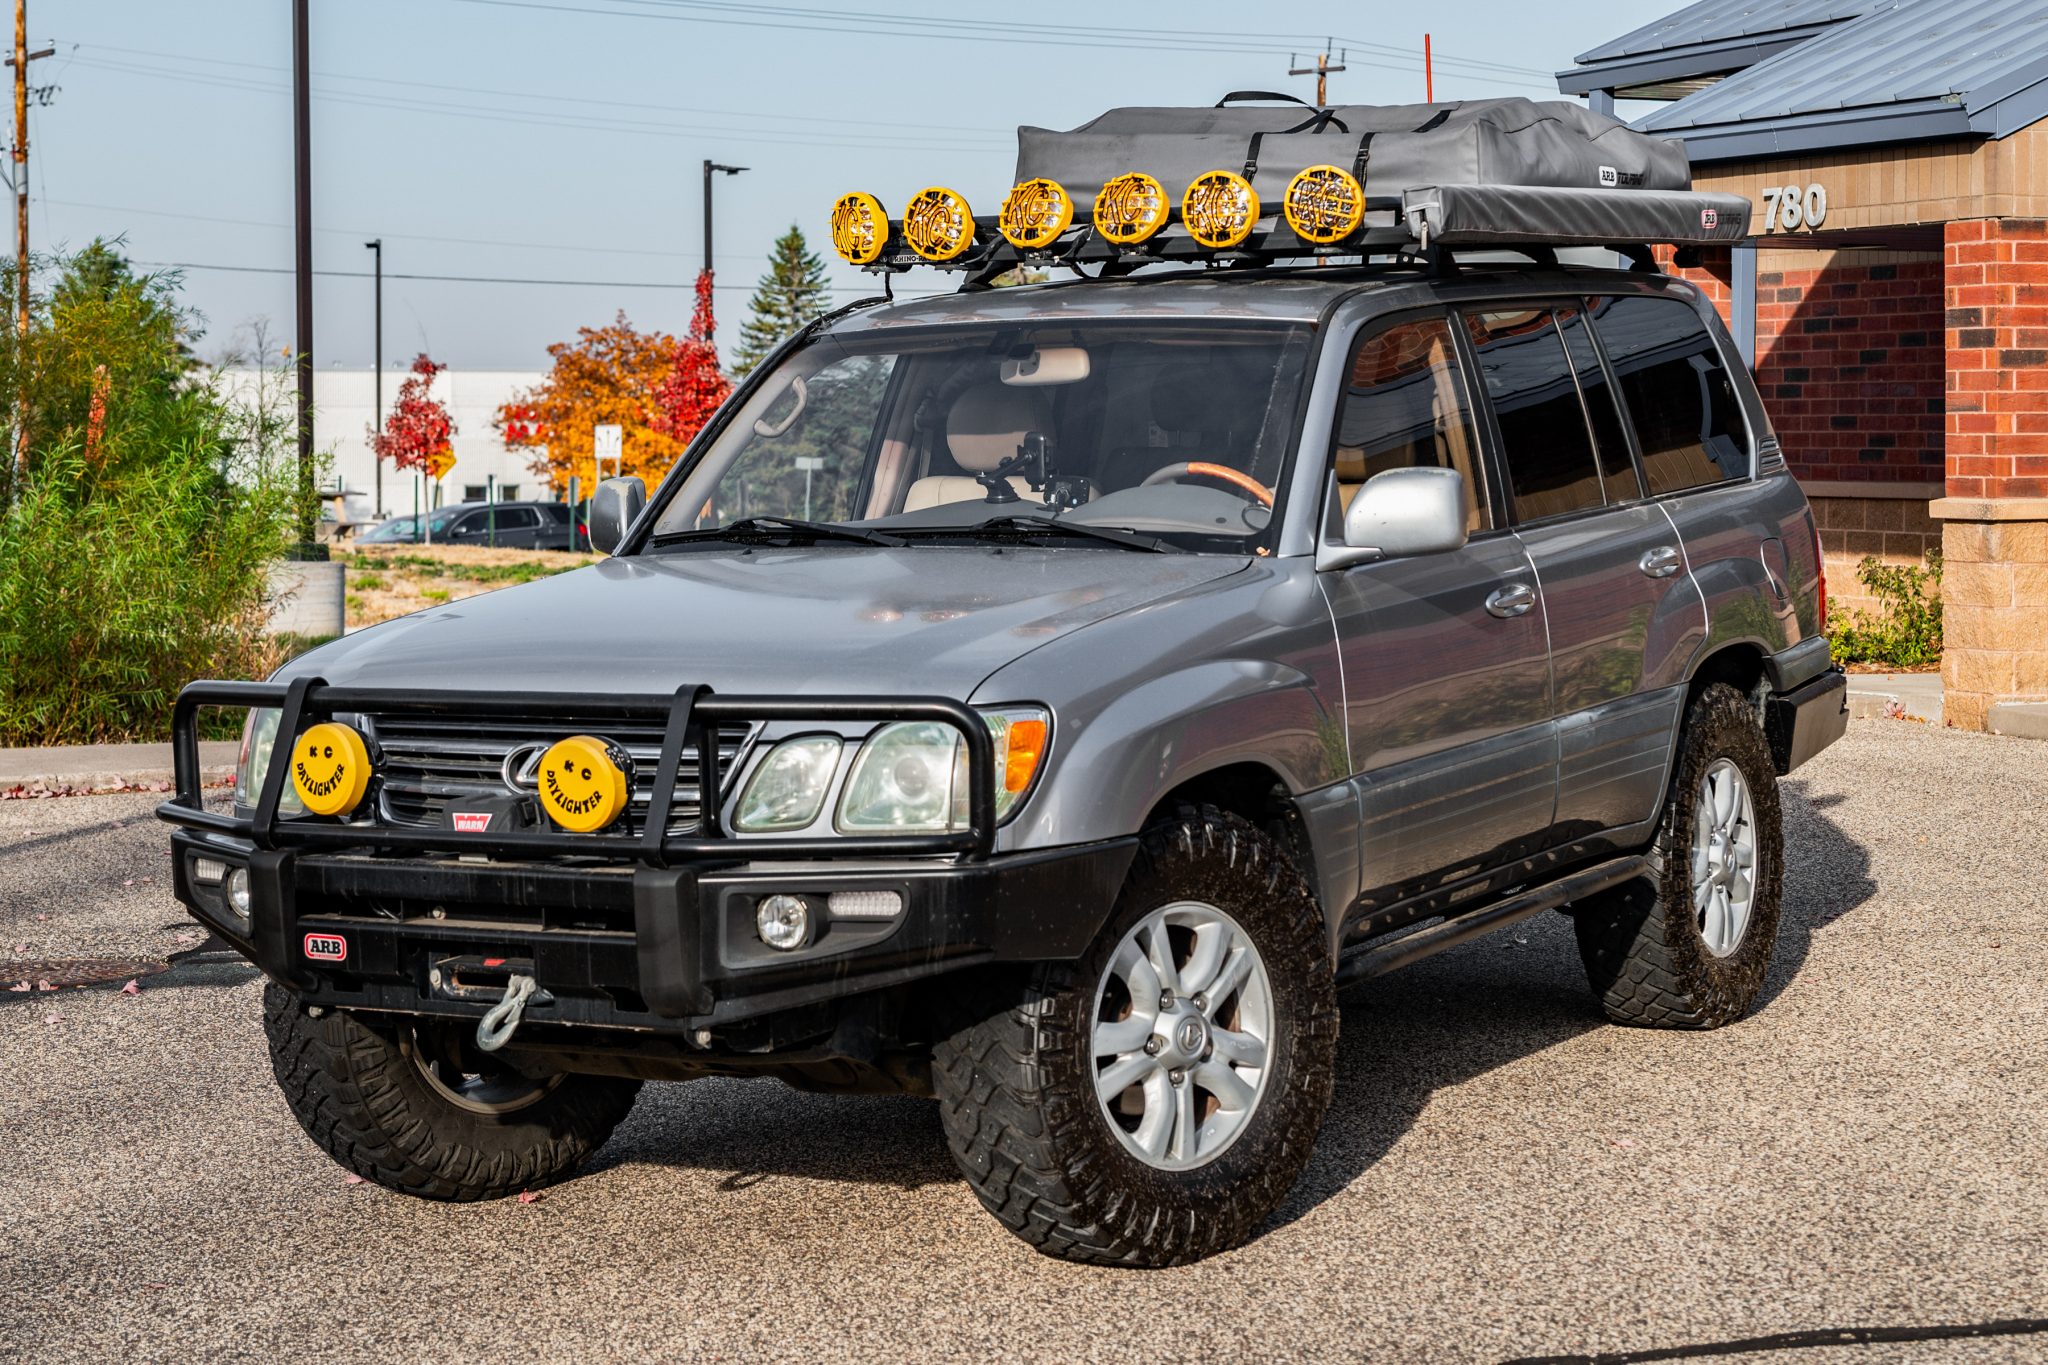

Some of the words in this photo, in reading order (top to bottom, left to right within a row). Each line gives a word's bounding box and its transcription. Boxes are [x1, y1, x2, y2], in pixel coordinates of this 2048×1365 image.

[910, 200, 950, 248] KC
[1007, 182, 1049, 229] KC
[1103, 177, 1145, 225] KC
[1192, 181, 1234, 235] KC
[1762, 183, 1827, 230] 780
[831, 203, 859, 252] KC
[894, 255, 930, 263] RHINO-RA
[297, 762, 345, 796] DAYLIGHTER
[547, 769, 603, 814] DAYLIGHTER
[457, 820, 484, 830] WARN
[310, 939, 342, 955] ARB
